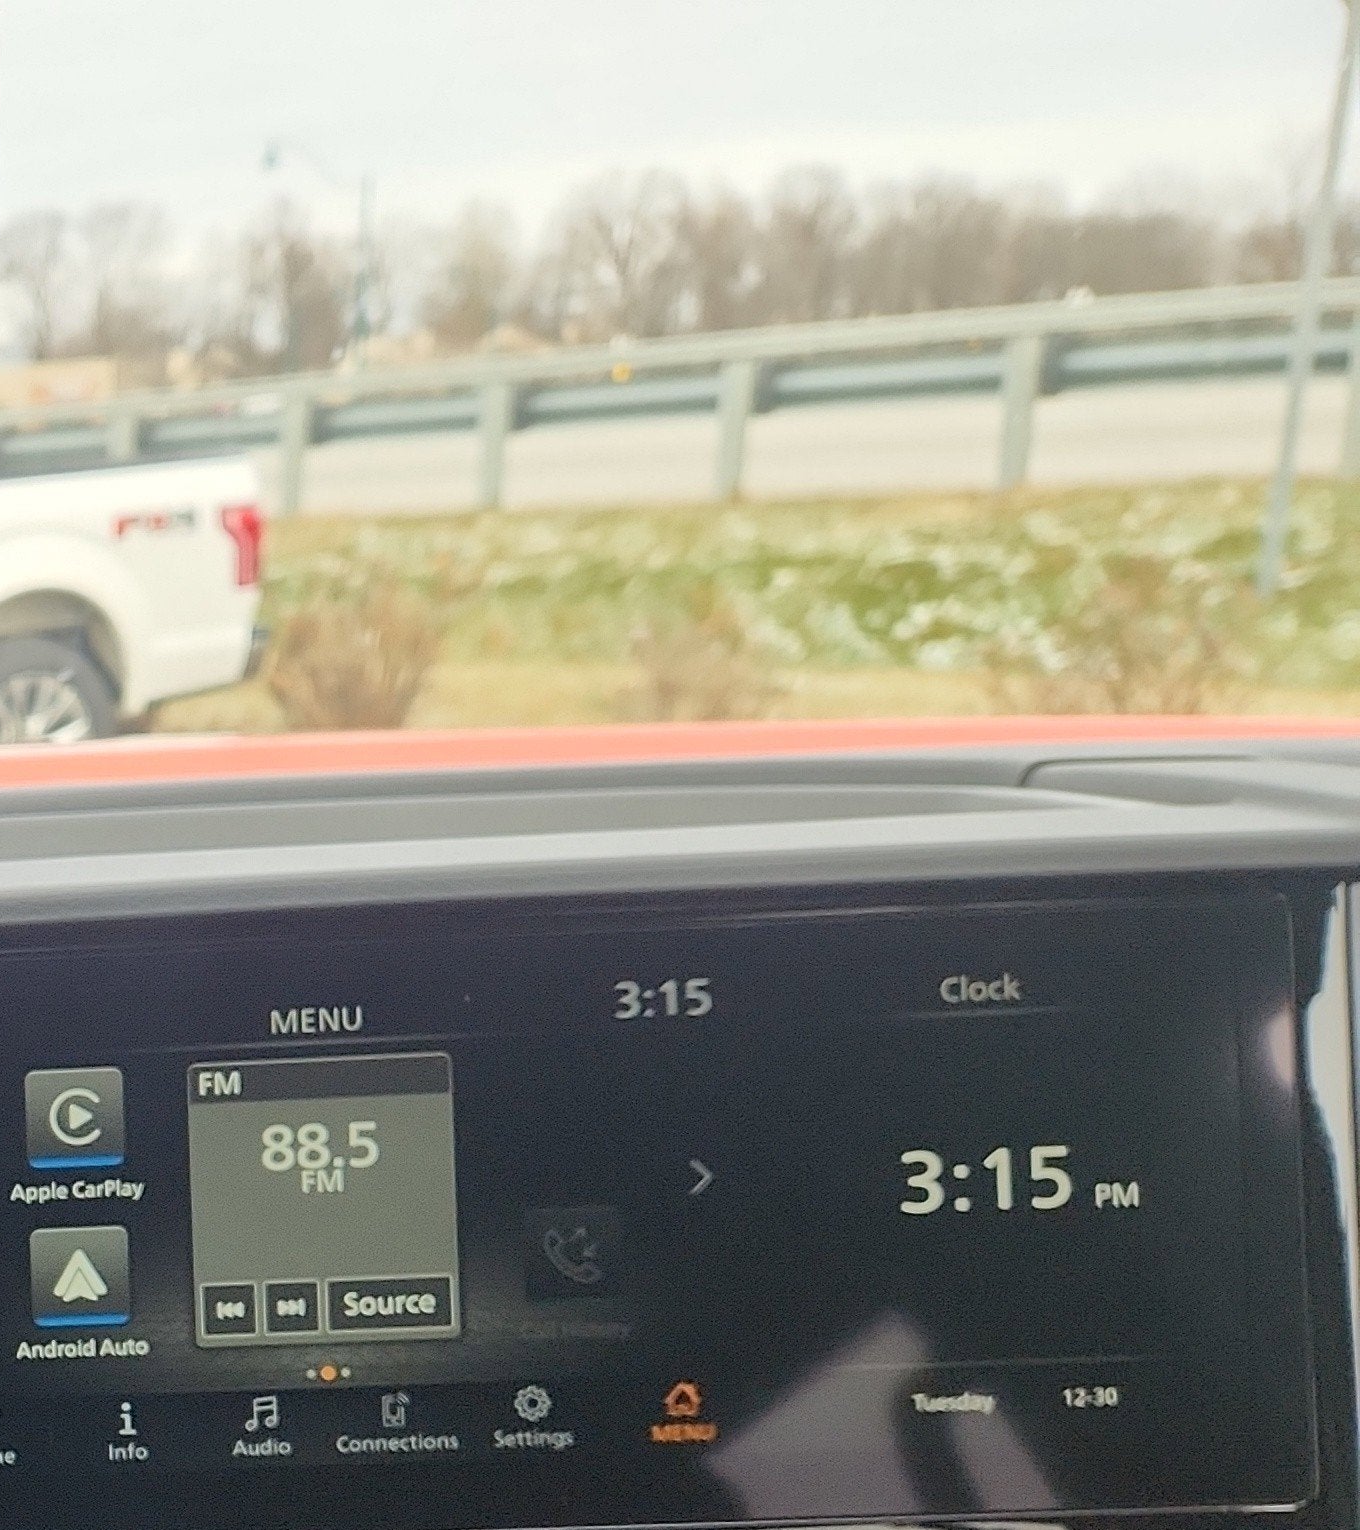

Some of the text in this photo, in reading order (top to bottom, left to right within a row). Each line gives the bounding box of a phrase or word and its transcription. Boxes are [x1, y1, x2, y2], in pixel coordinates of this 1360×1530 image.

[613, 976, 713, 1021] 3:15
[939, 971, 1022, 1004] Clock
[269, 1005, 364, 1036] MENU
[197, 1070, 243, 1097] FM
[260, 1120, 380, 1172] 88.5
[9, 1177, 145, 1205] Apple CarPlay
[300, 1168, 345, 1194] FM
[899, 1143, 1075, 1216] 3:15
[1094, 1181, 1141, 1209] PM
[342, 1290, 437, 1319] Source
[15, 1337, 150, 1361] Android Auto
[910, 1390, 997, 1415] Tuesday
[1062, 1385, 1119, 1410] 12-30
[336, 1432, 459, 1455] Connections
[493, 1426, 574, 1452] Settings
[650, 1423, 720, 1444] MENU
[107, 1441, 149, 1462] Info
[231, 1436, 292, 1458] Audio
